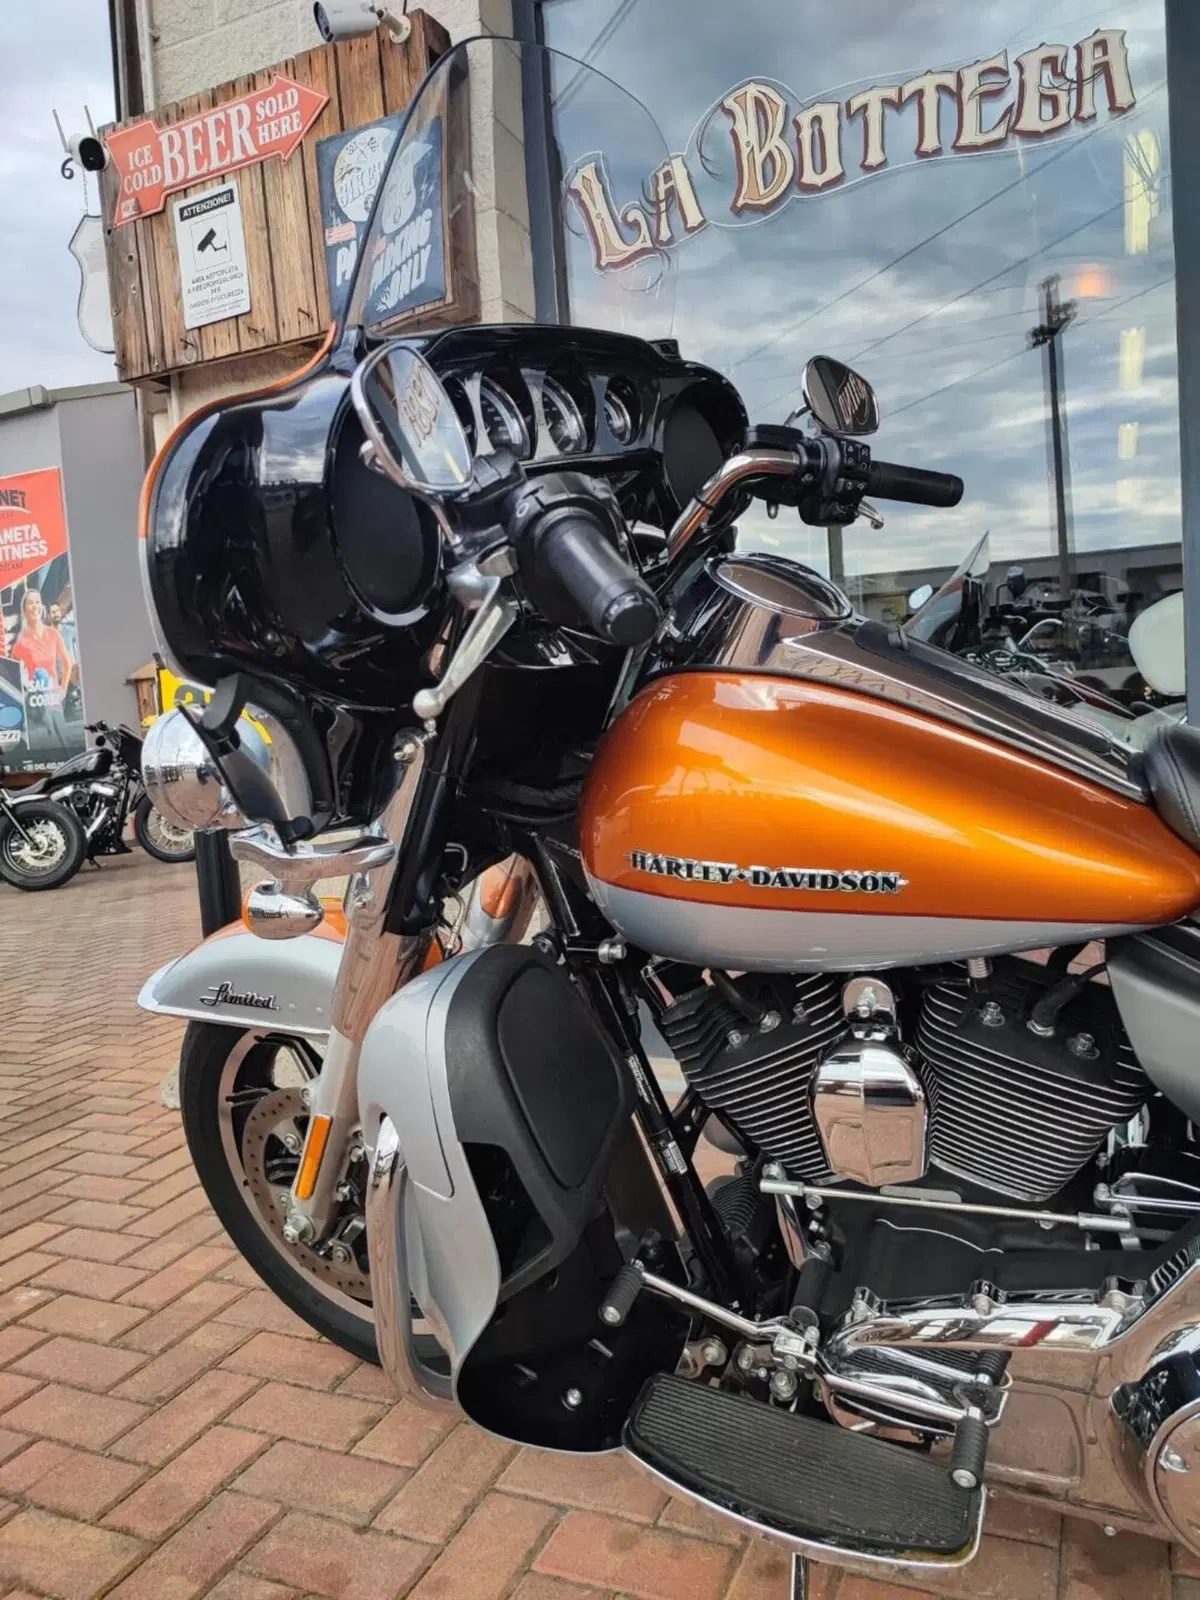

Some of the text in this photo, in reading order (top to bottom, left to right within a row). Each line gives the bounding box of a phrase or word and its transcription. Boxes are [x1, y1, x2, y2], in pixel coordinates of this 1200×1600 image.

[255, 87, 299, 122] SOLD
[257, 111, 302, 146] HERE
[128, 145, 153, 170] ICE
[158, 103, 258, 188] BEER
[570, 28, 1137, 271] LA BOTTEGA
[123, 165, 162, 194] COLD
[182, 193, 231, 218] ATTENZIONE!
[200, 981, 281, 1011] Limited
